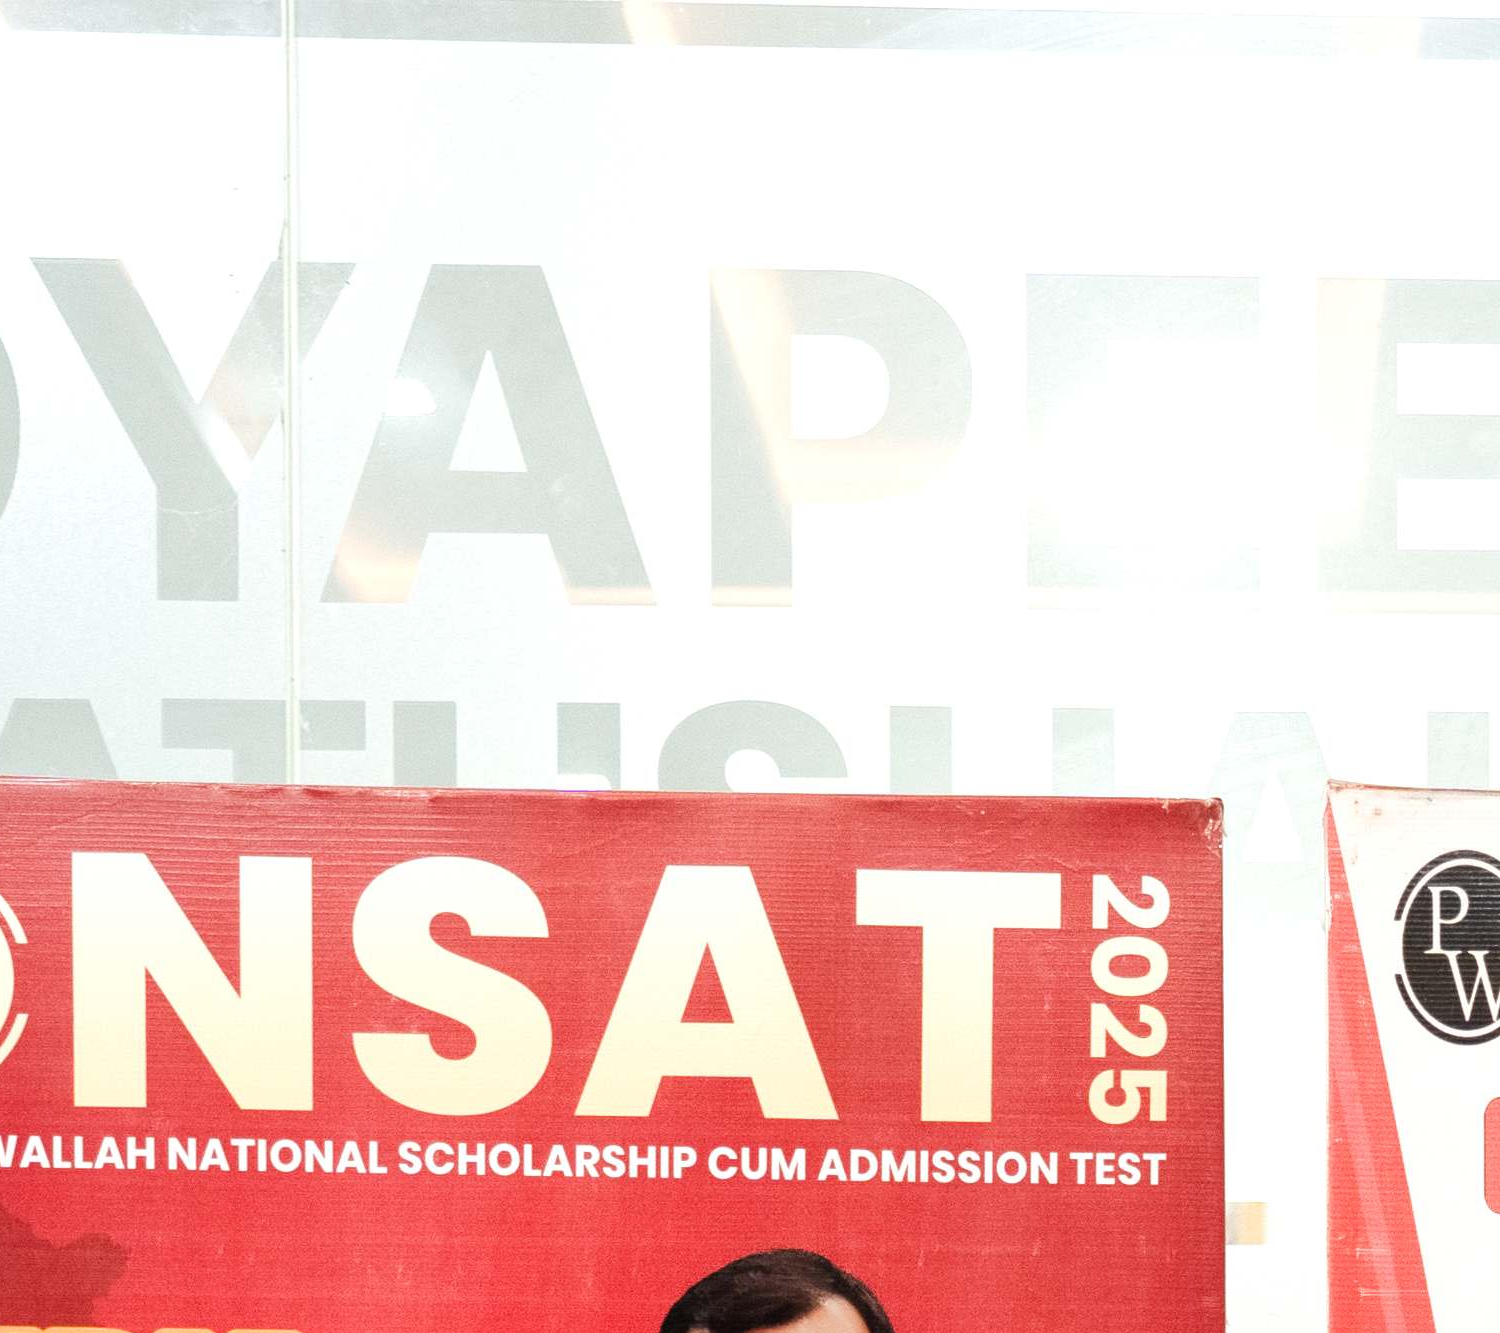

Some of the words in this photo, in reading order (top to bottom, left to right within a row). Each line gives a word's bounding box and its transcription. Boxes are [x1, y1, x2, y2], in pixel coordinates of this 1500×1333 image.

[70, 850, 1062, 1123] NSAT
[1088, 873, 1171, 1125] 2025
[167, 1136, 389, 1175] NATIONAL
[397, 1140, 698, 1179] SCHOLARSHIP
[707, 1145, 807, 1181] CUM
[817, 1148, 1059, 1185] ADMISSION
[1069, 1151, 1167, 1186] TEST
